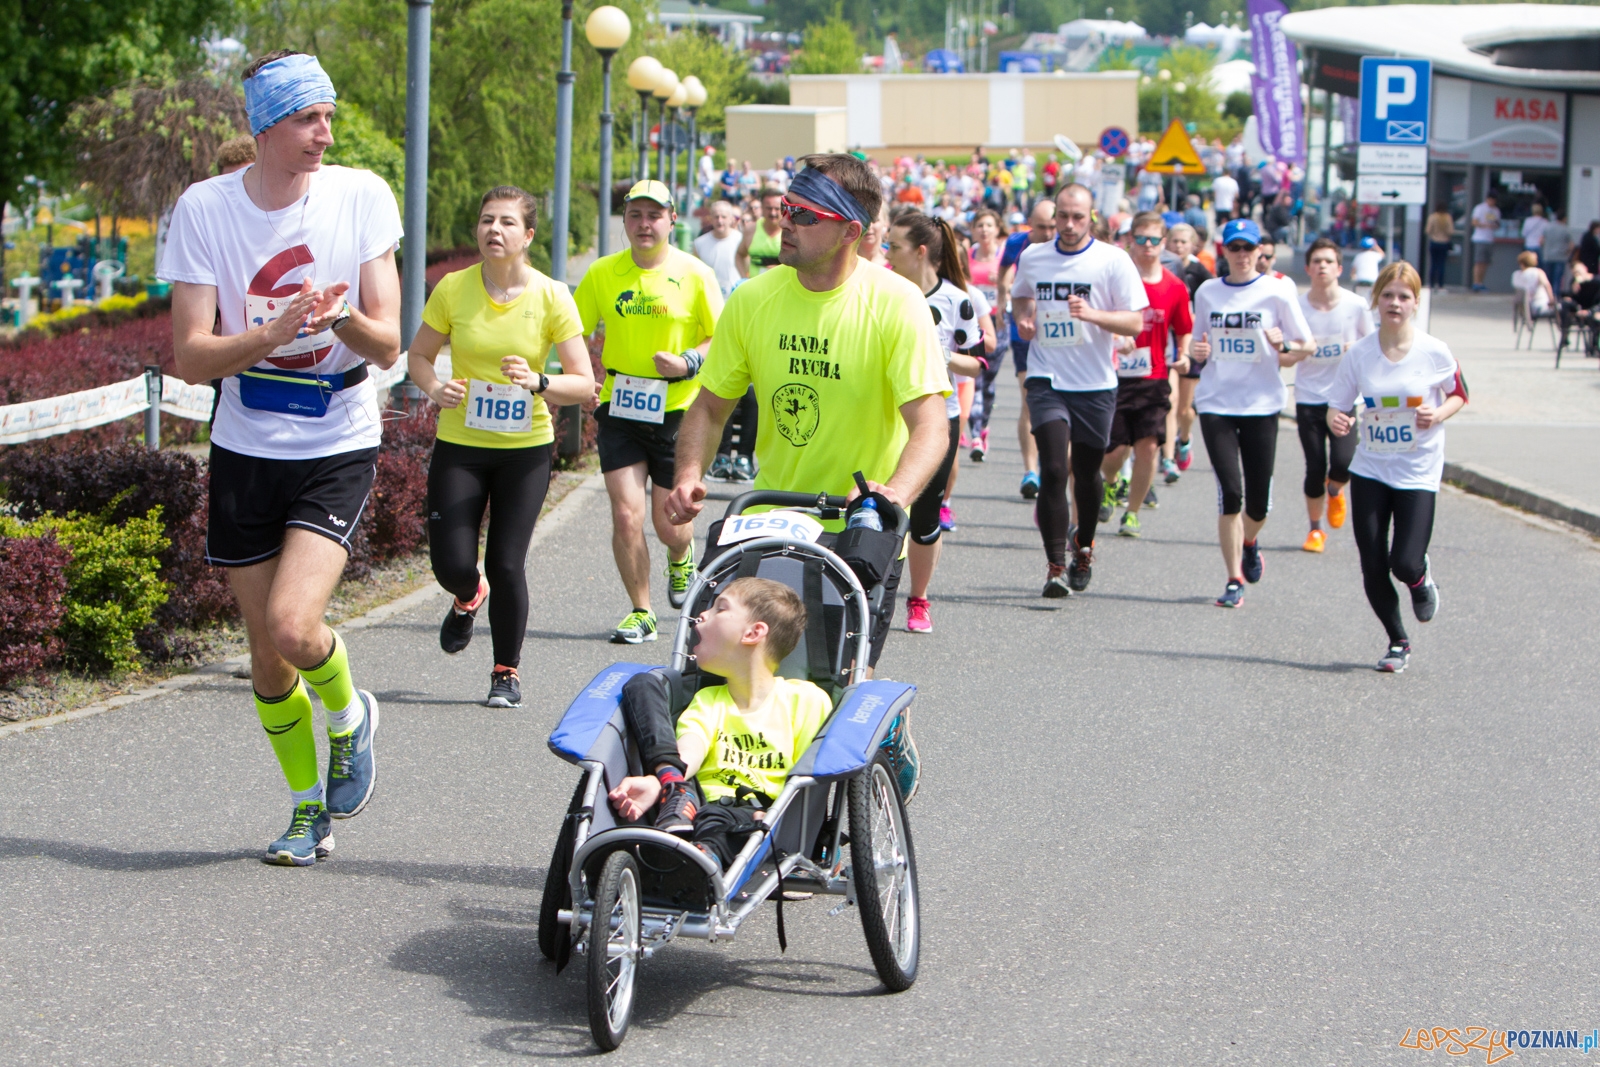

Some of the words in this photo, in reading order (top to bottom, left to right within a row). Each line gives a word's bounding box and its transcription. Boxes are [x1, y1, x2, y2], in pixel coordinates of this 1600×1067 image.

[1375, 65, 1417, 120] P
[1494, 97, 1559, 121] KASA
[1043, 321, 1074, 338] 1211
[779, 333, 829, 355] BANDA
[1218, 338, 1255, 354] 1163
[1311, 344, 1341, 358] 263
[789, 357, 841, 380] RYCHA
[475, 396, 526, 420] 1188
[615, 388, 661, 412] 1560
[1368, 424, 1412, 443] 1406
[733, 518, 810, 541] 1696
